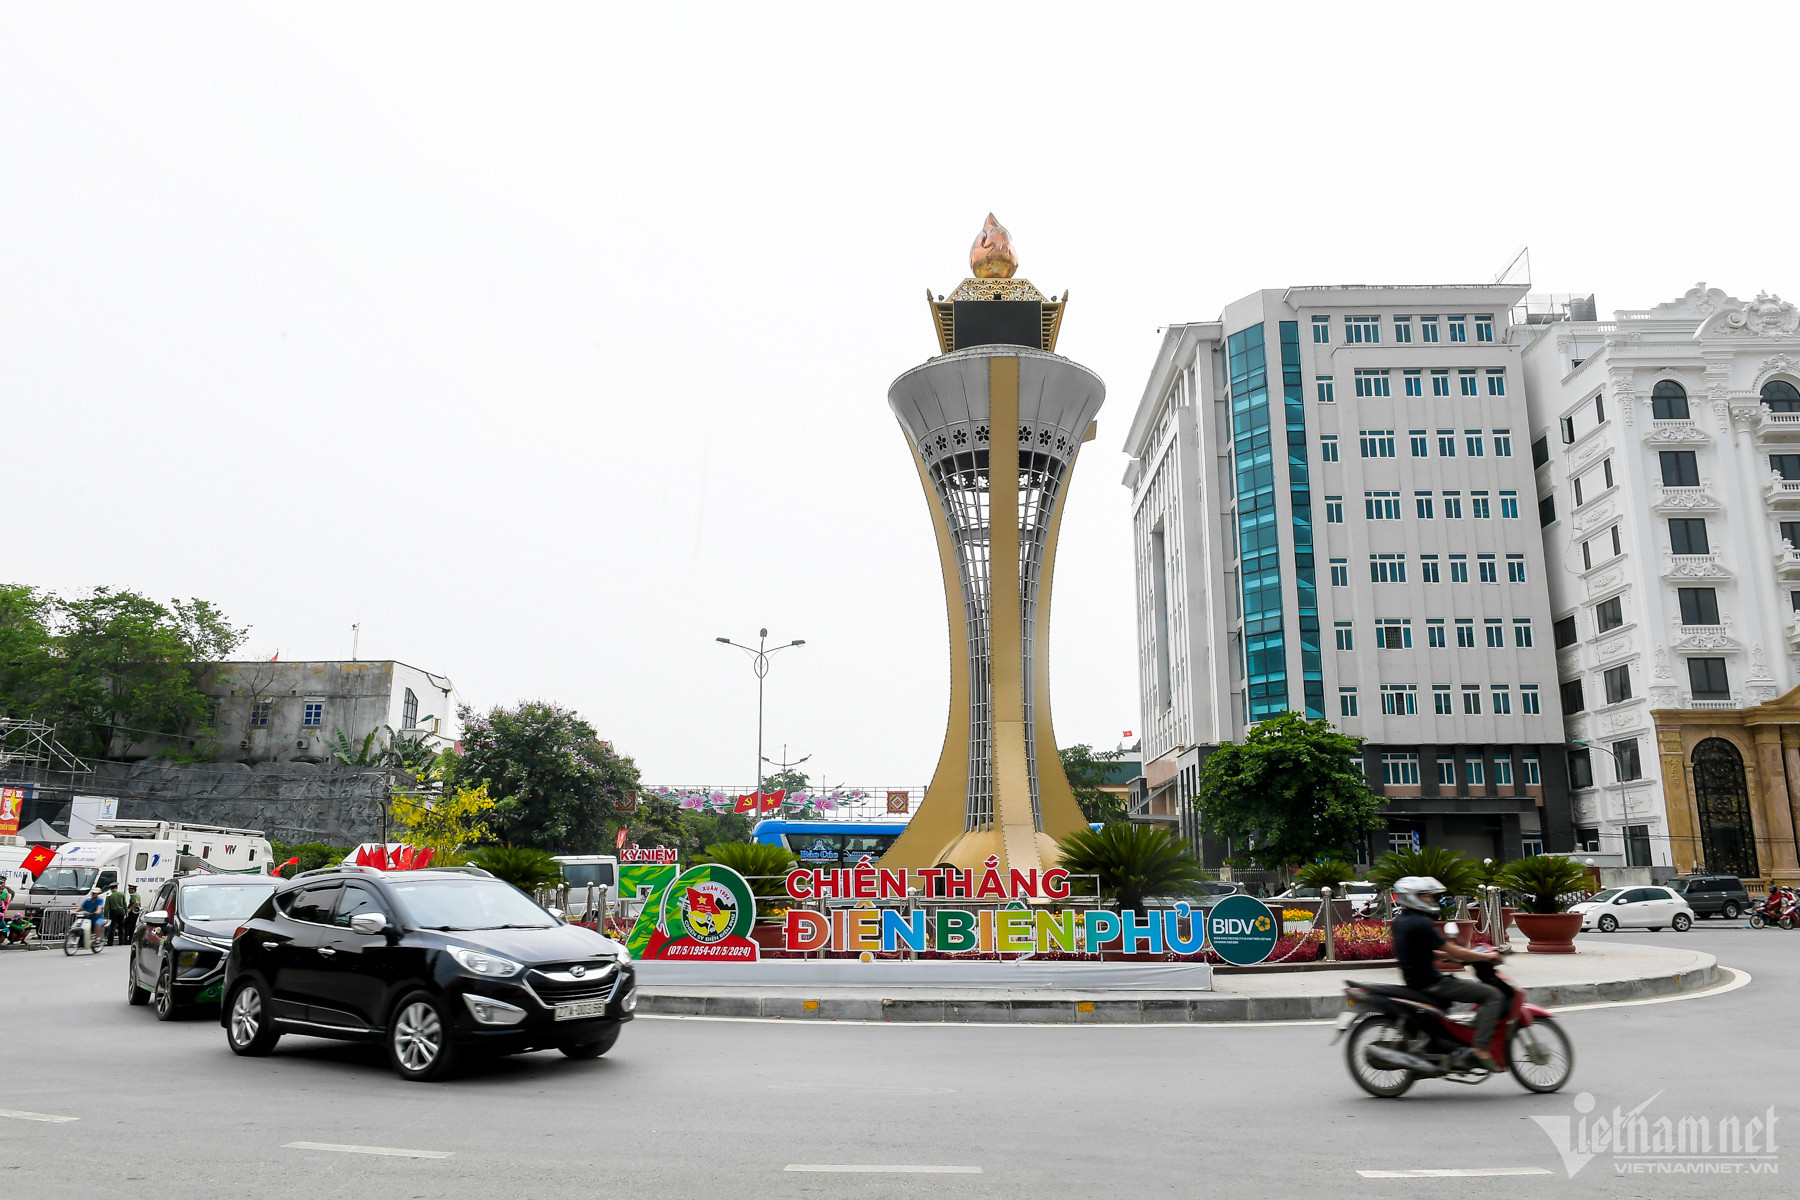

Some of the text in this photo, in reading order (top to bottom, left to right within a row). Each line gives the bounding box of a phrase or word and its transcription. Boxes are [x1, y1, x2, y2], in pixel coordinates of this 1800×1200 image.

[225, 845, 237, 855] VTV
[620, 844, 678, 864] KỶ NIỆM
[785, 853, 1072, 900] CHIẾN THẮNG
[719, 889, 731, 900] 1954
[782, 899, 1205, 963] ĐIỆN BIÊN PHỦ
[1212, 918, 1255, 935] BIDV
[667, 945, 752, 957] (07/5/1954-07/5/2024)
